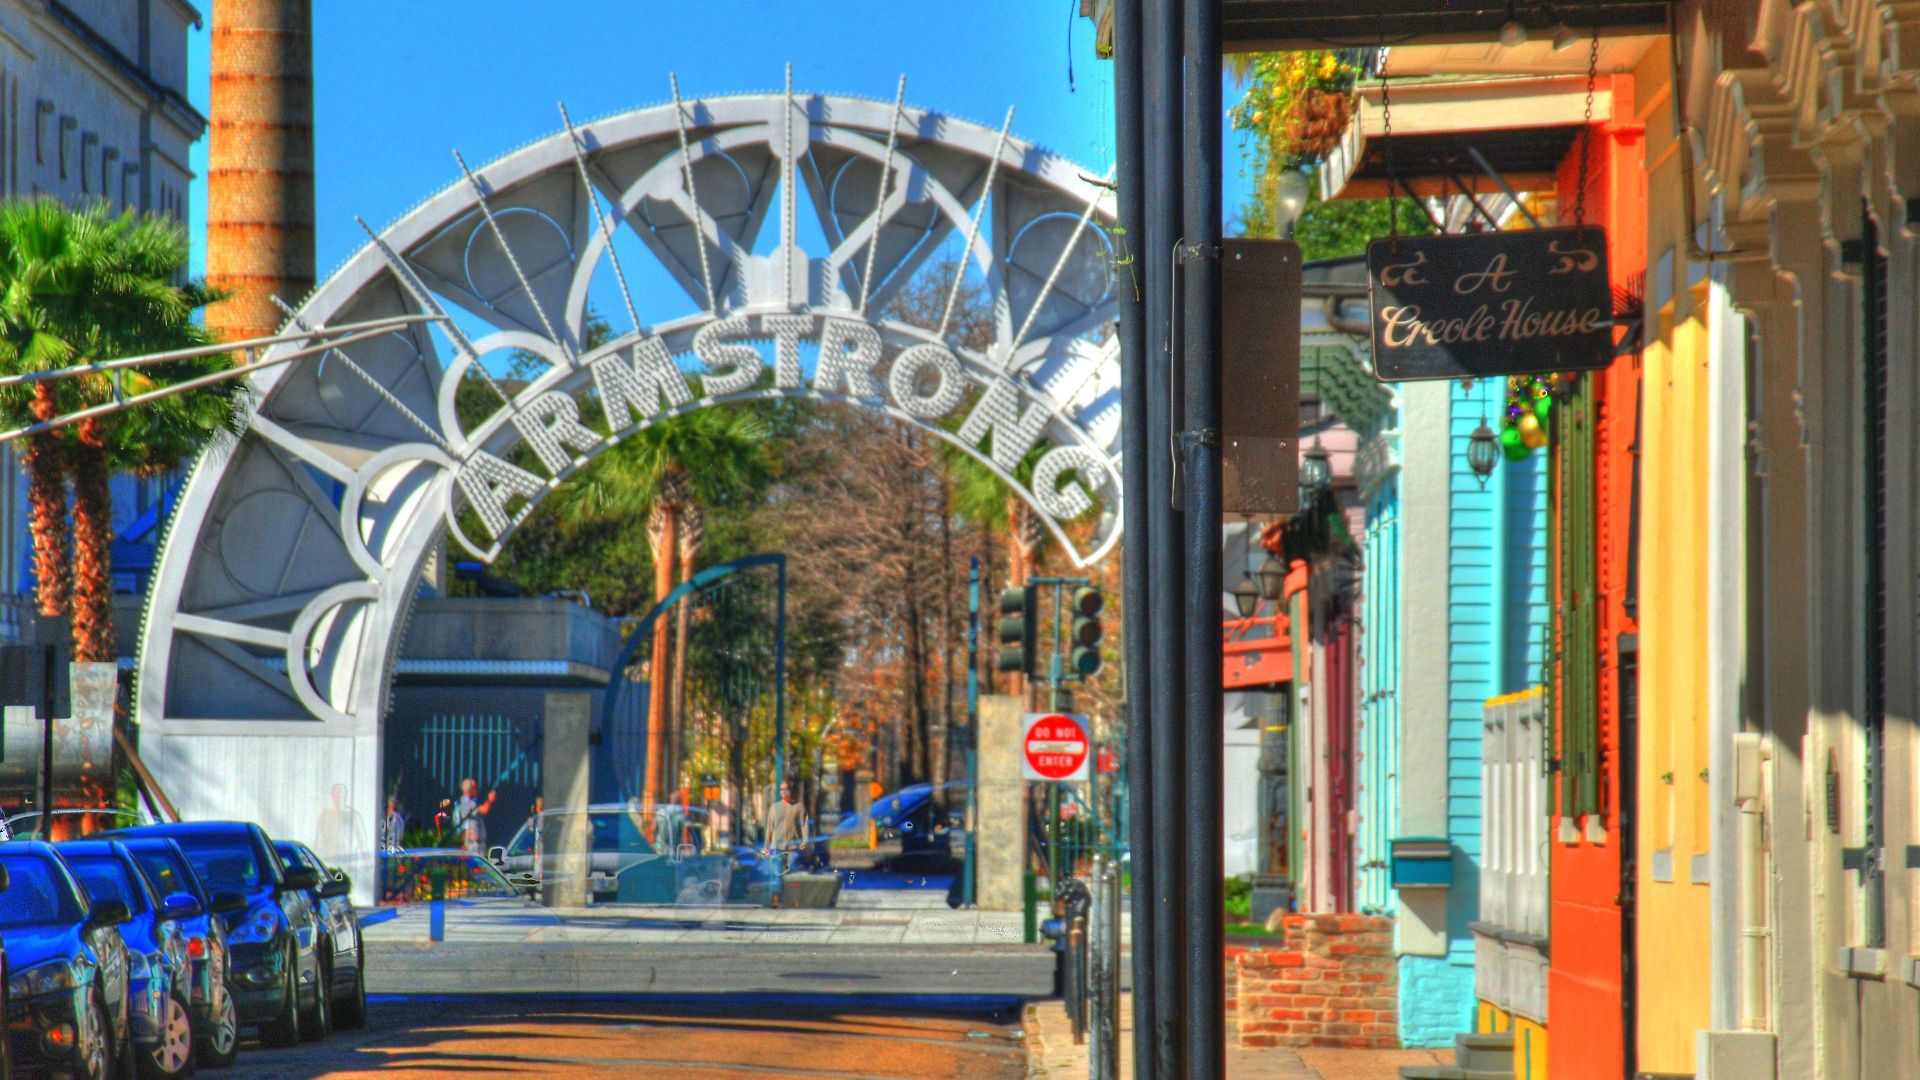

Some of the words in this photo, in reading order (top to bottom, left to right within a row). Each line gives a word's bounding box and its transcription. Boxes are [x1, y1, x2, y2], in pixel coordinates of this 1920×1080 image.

[1455, 253, 1518, 294] A
[1382, 305, 1495, 347] Creole
[1500, 297, 1602, 339] House
[455, 314, 1108, 541] ARMSTRONG
[1035, 727, 1050, 738] DO
[1056, 727, 1076, 738] NOT
[1038, 755, 1073, 767] ENTER
